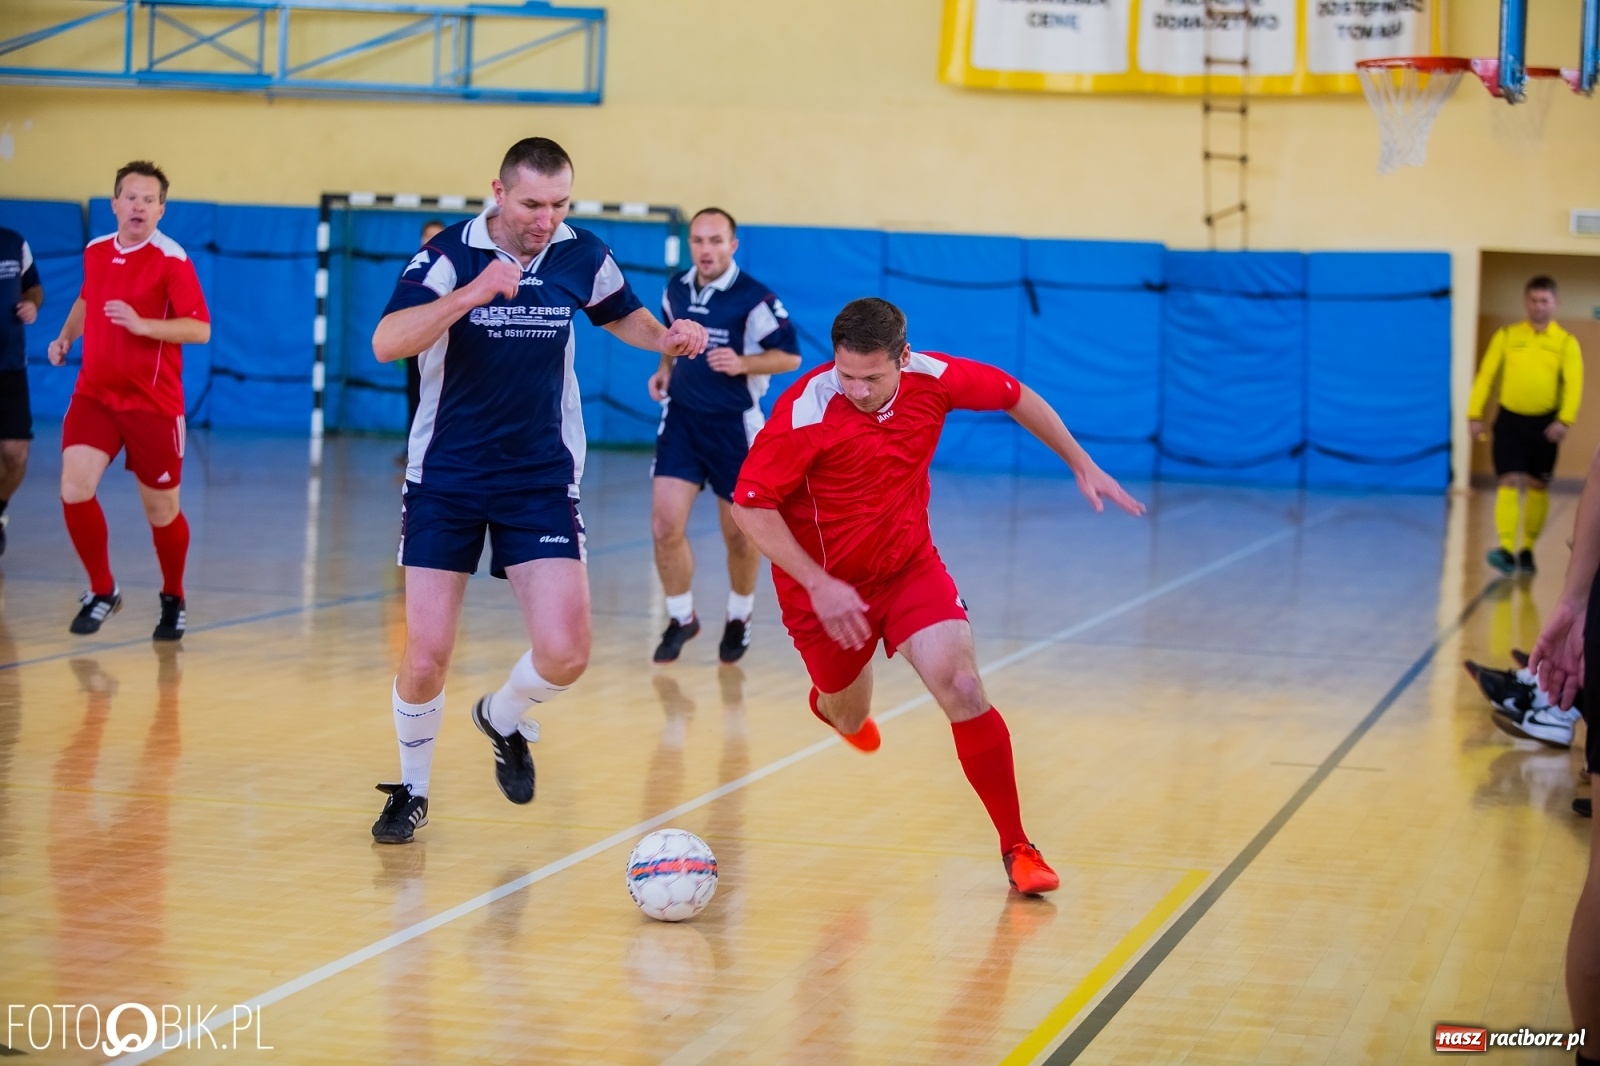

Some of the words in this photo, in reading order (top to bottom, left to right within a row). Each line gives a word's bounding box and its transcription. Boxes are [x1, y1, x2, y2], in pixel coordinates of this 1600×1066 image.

[489, 305, 527, 316] PETER
[528, 306, 571, 317] ZERGES
[504, 329, 557, 338] 0511/777777
